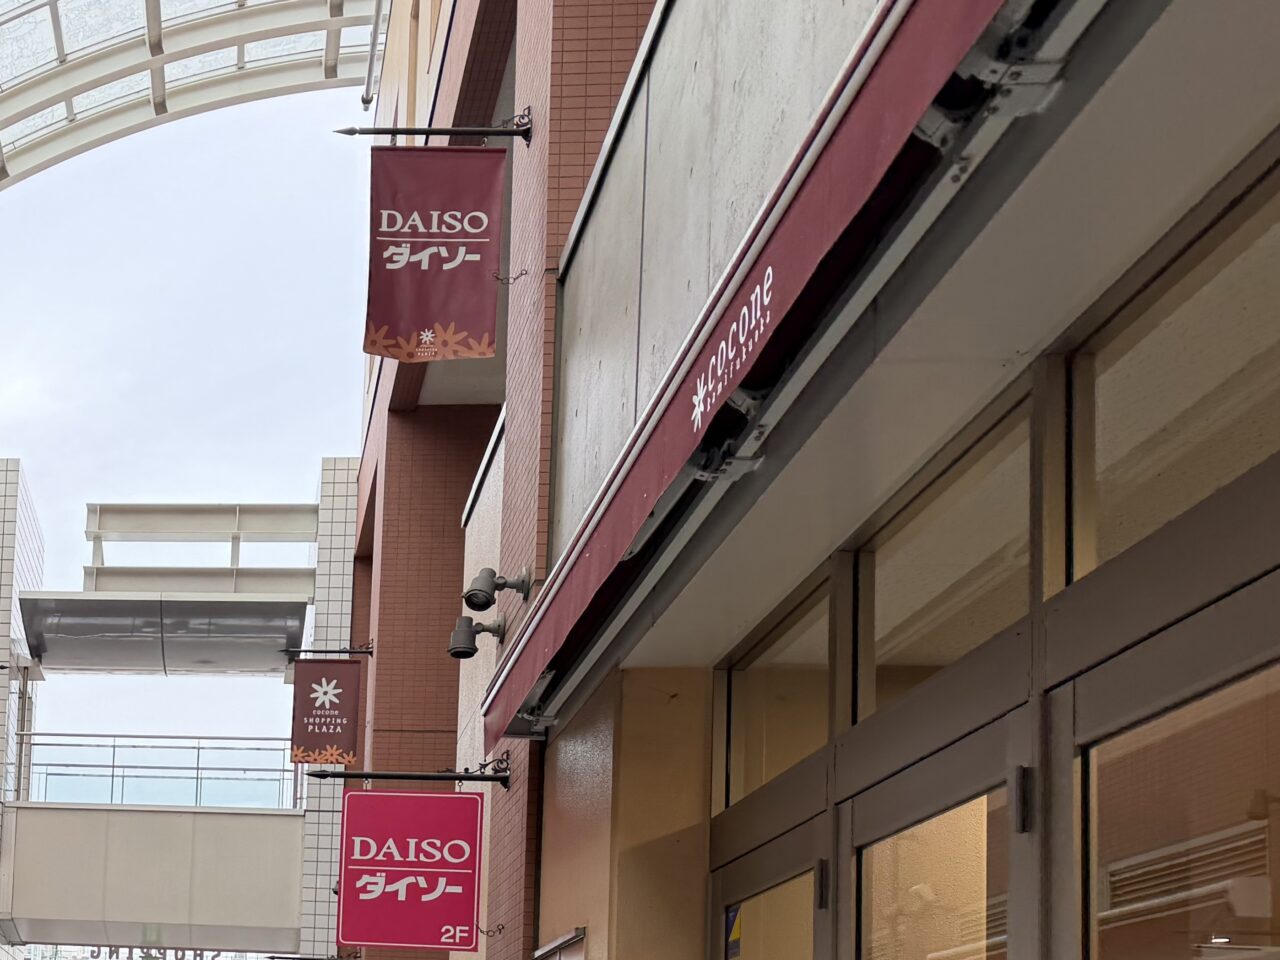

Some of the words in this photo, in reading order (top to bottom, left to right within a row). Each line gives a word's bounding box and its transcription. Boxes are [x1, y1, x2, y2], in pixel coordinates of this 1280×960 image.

[379, 210, 489, 233] DAISO
[383, 243, 480, 270] ダイソー
[708, 265, 773, 392] cocone
[308, 725, 342, 733] PLAZA
[350, 836, 471, 863] DAISO
[355, 872, 463, 901] ダイソー
[440, 925, 469, 943] 2F
